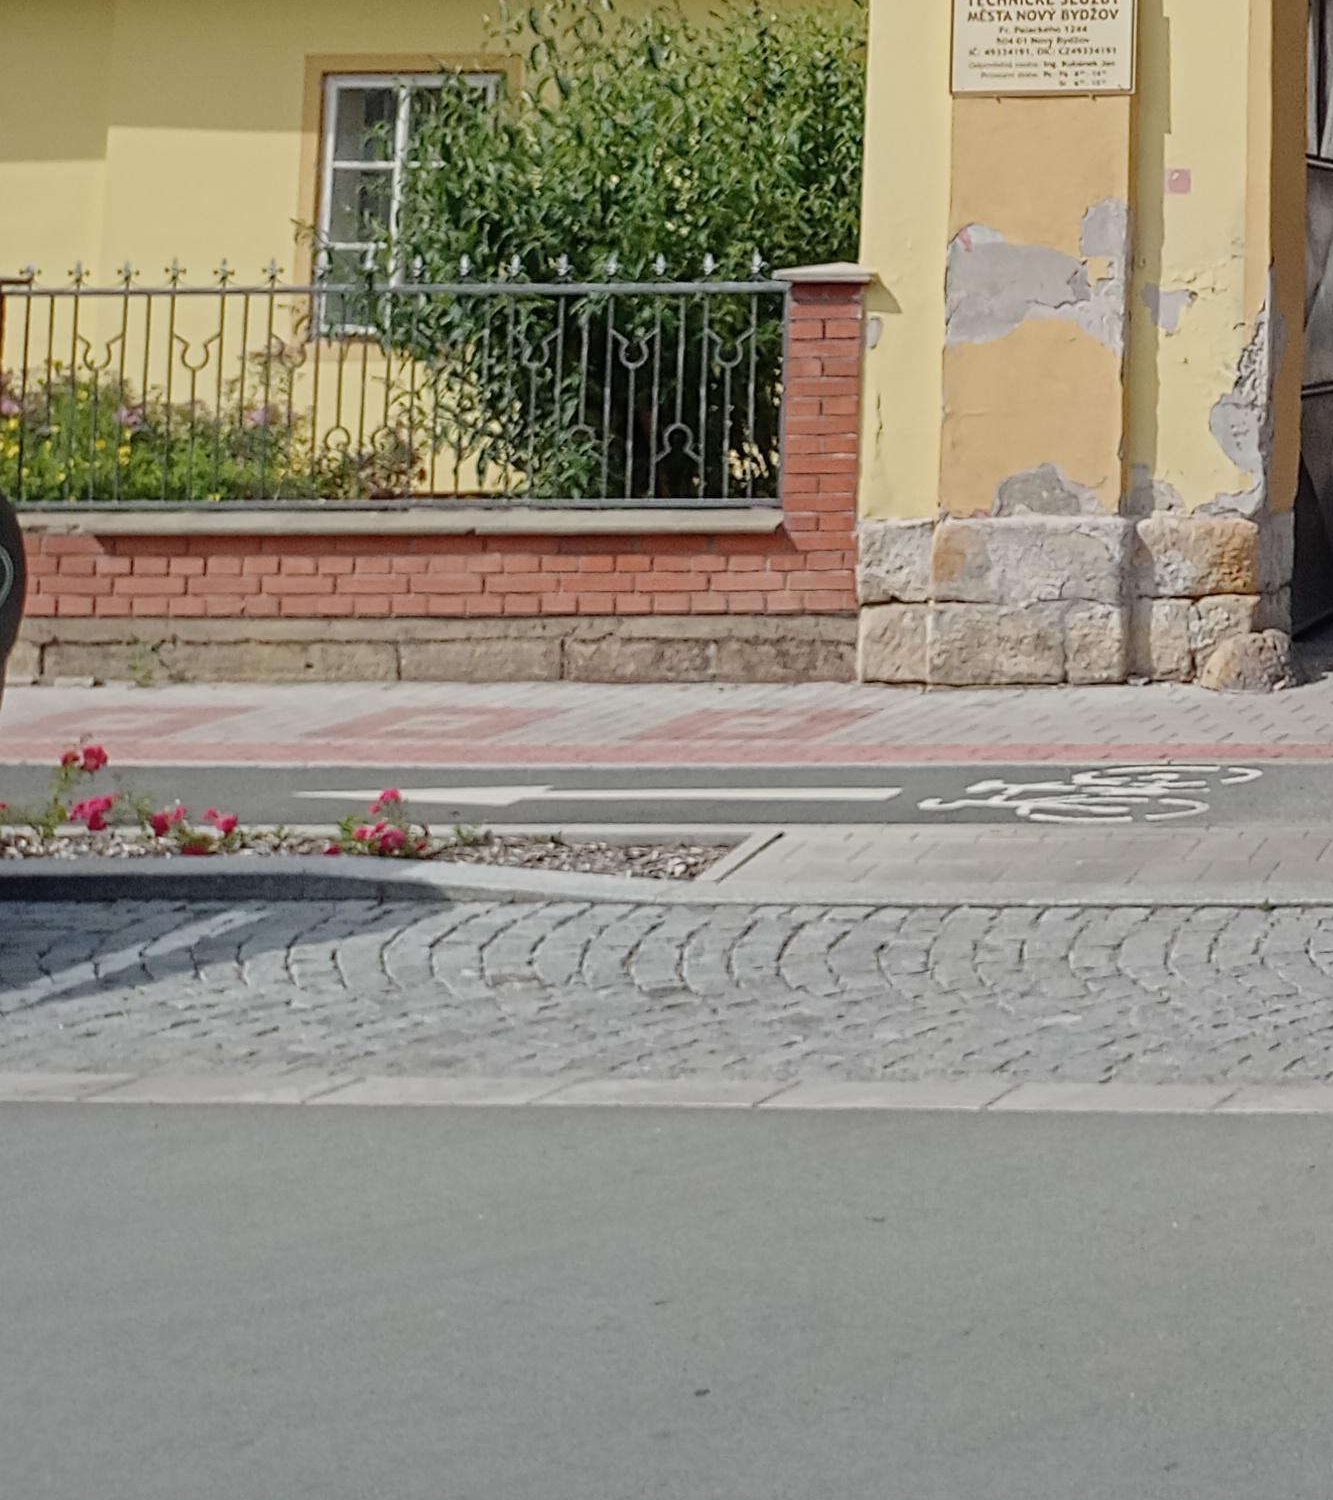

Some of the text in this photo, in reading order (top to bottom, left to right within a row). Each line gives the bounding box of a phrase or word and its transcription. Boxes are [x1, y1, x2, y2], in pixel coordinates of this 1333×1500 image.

[967, 7, 1120, 22] MĚSTA NOVÝ BYDŽOV
[1065, 25, 1088, 33] 1244
